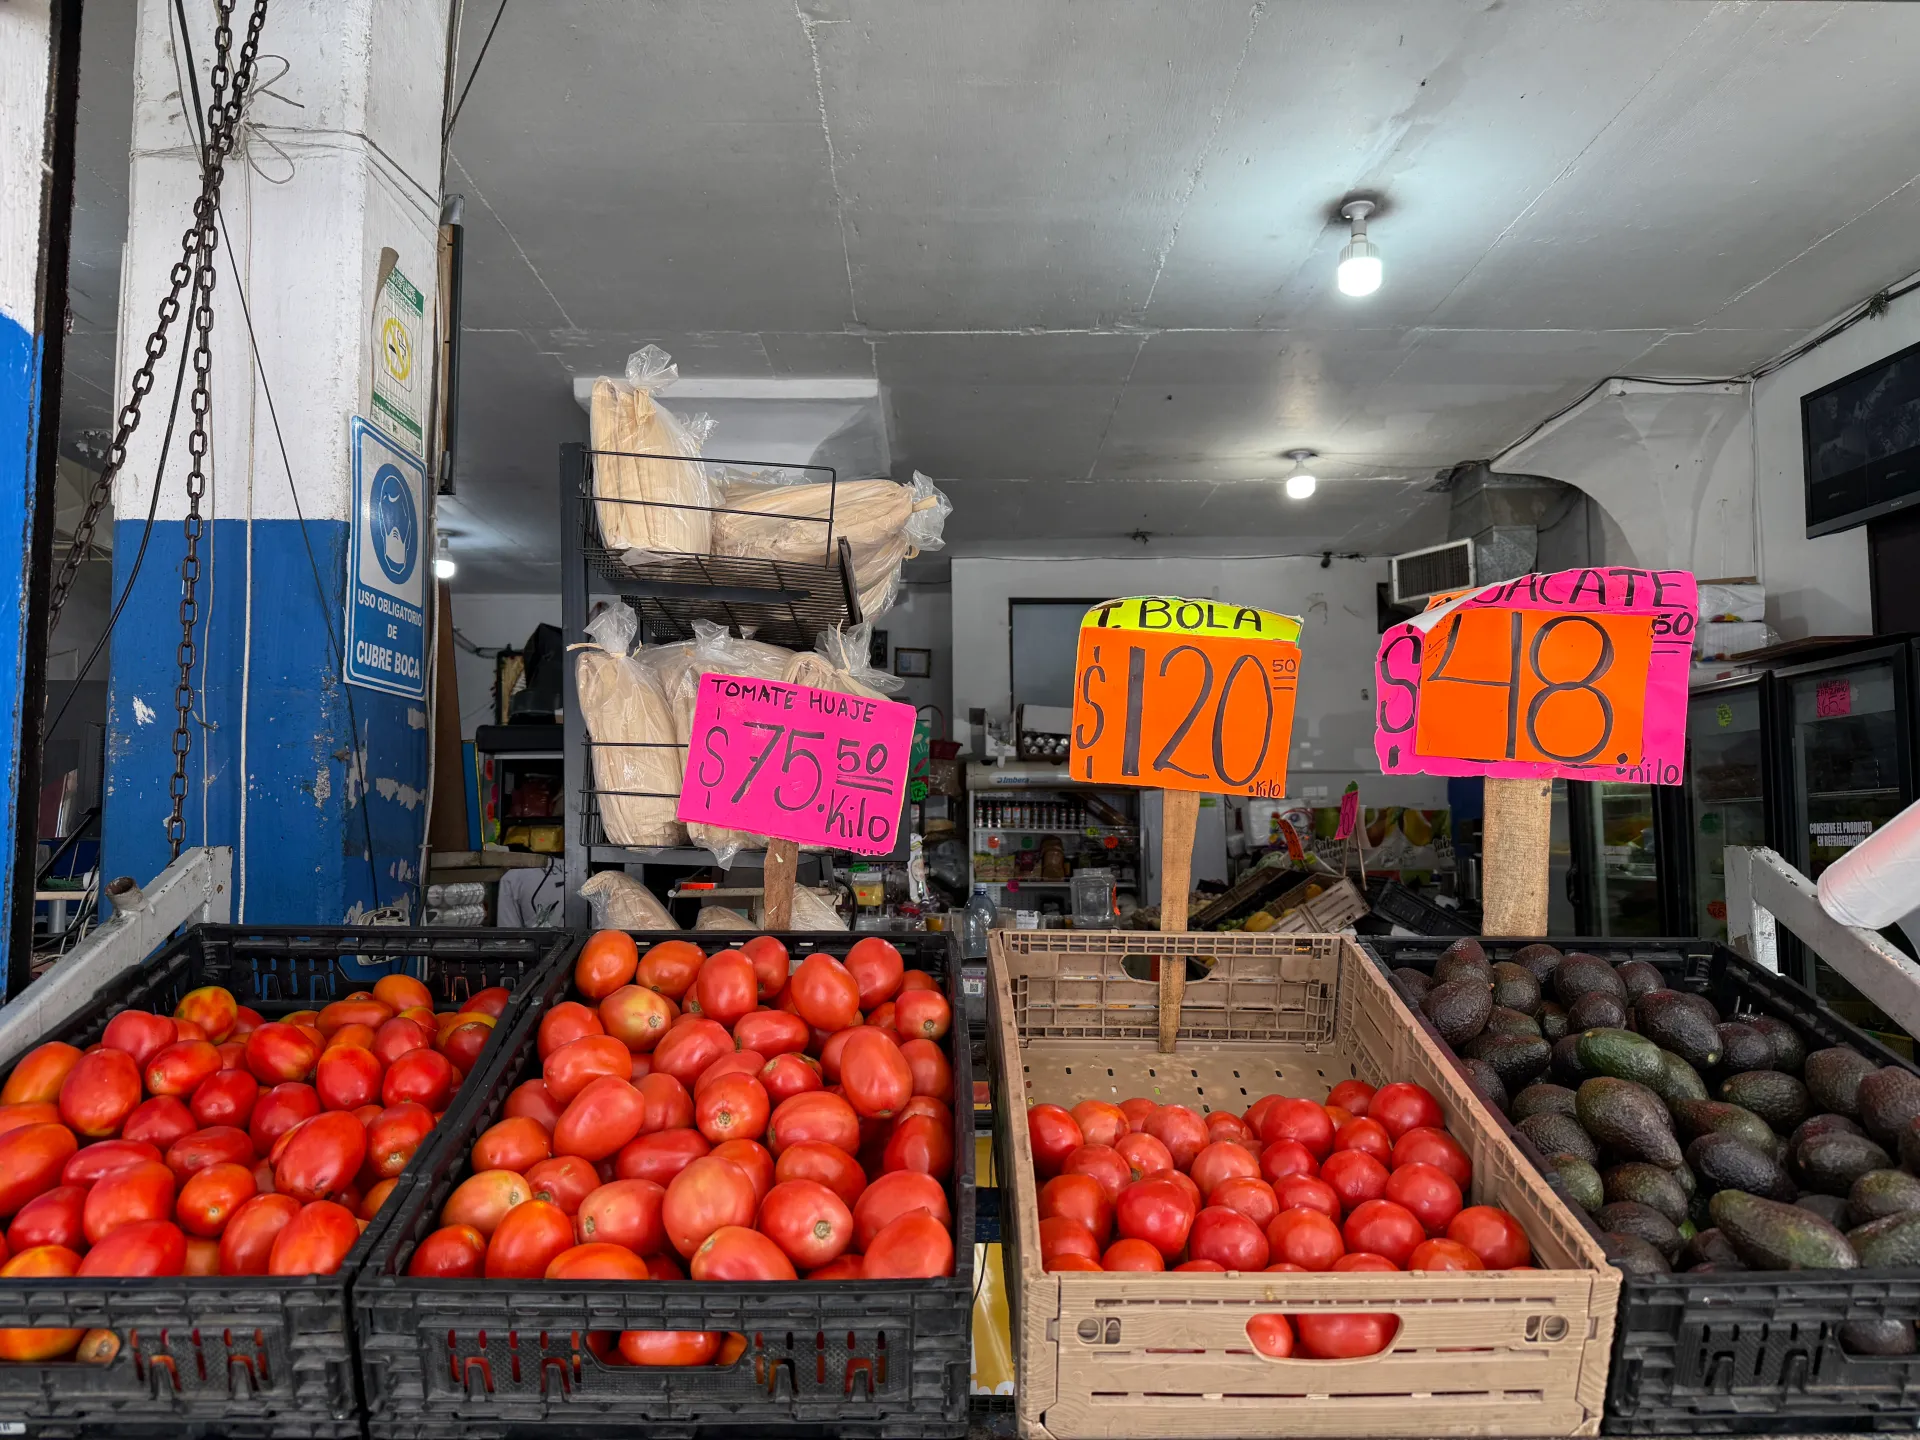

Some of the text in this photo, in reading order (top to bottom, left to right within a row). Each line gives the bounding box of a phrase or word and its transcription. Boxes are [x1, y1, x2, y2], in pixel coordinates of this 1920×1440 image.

[358, 588, 423, 627] USO OBLIGATORIO
[1139, 599, 1263, 633] BOLA
[387, 623, 398, 640] DE
[356, 640, 421, 680] CUBRE BOCA
[1272, 658, 1297, 673] 50
[711, 679, 878, 723] TOMATE HUAJE
[836, 737, 889, 776] 50
[825, 788, 891, 843] Kilo
[1809, 821, 1873, 835] CONSERVE EL PRODUCTO
[1817, 835, 1824, 847] EN
